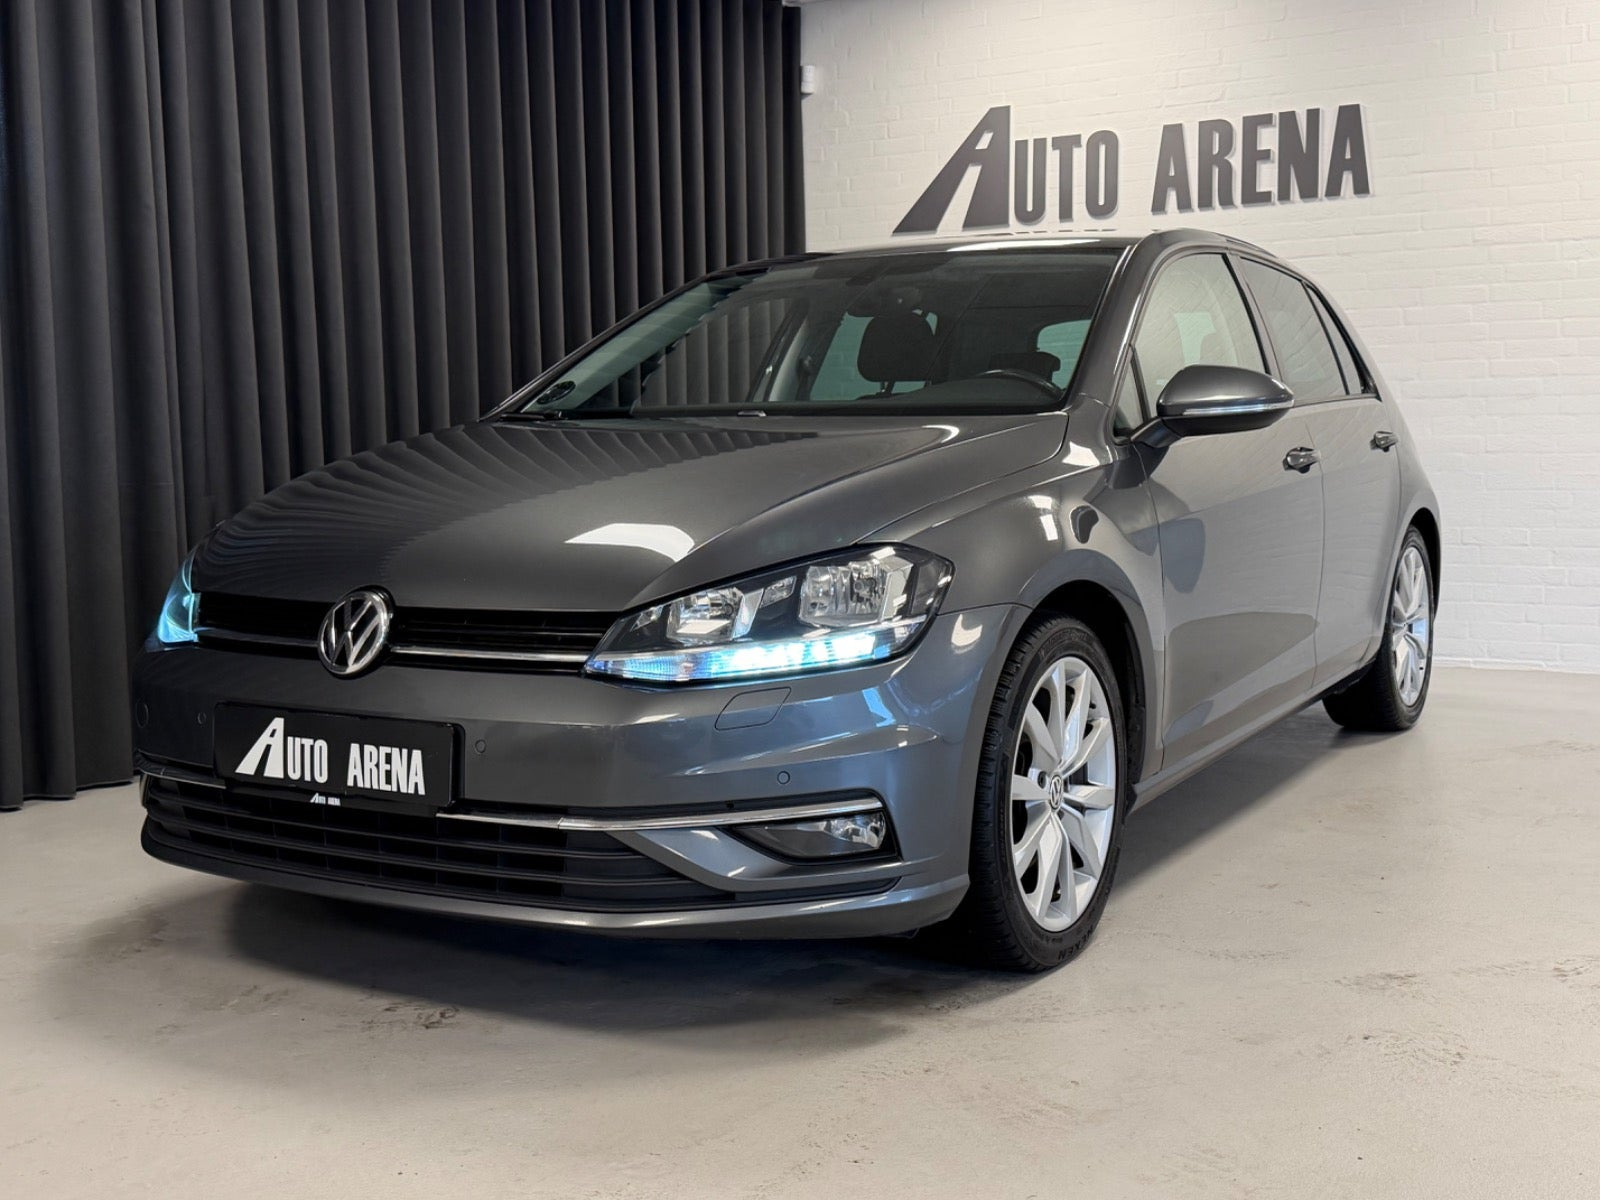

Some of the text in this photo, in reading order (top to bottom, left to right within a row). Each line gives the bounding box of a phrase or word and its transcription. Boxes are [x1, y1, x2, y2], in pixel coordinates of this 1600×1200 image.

[892, 103, 1370, 233] AUTO ARENA
[235, 717, 426, 795] AUTO ARENA
